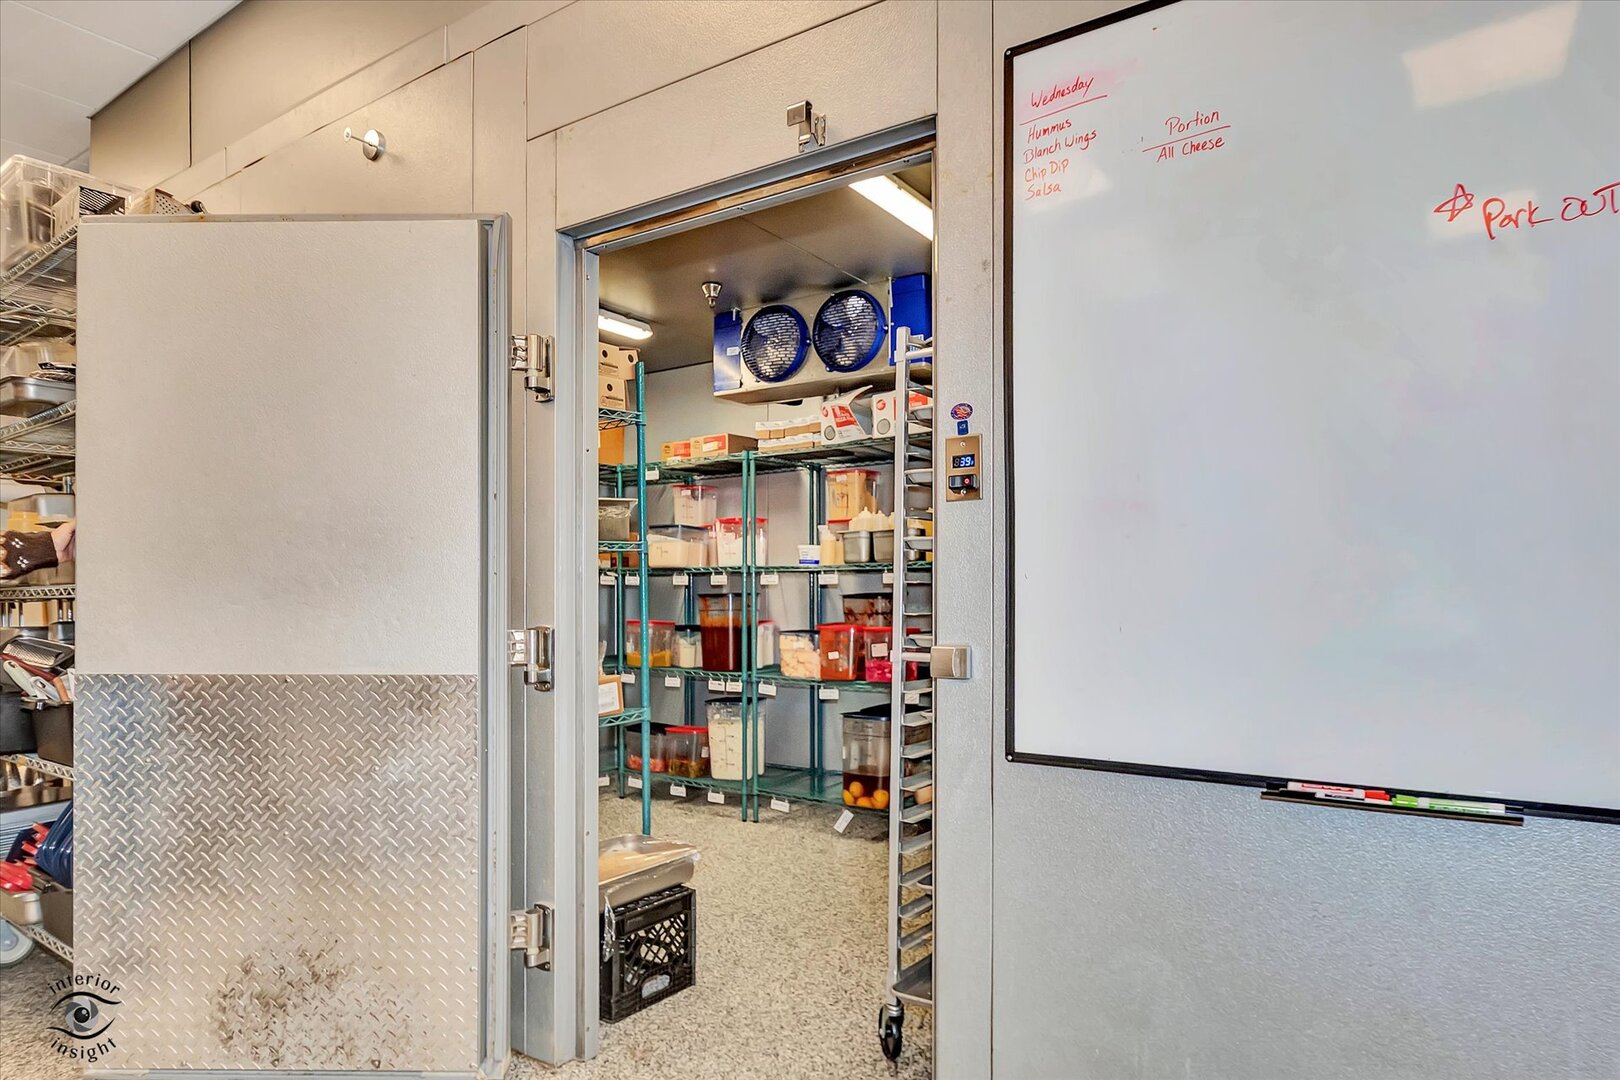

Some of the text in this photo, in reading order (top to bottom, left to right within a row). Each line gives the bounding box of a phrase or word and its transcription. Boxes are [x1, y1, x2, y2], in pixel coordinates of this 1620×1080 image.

[1030, 76, 1094, 108] Wednesday
[1027, 118, 1072, 143] Hummus
[1164, 111, 1220, 135] Portion
[1023, 130, 1097, 164] Blanch Wings
[1156, 136, 1225, 163] All Cheese
[1024, 158, 1069, 182] Chip Dip
[1025, 182, 1062, 200] Salsa
[1482, 197, 1553, 240] Park
